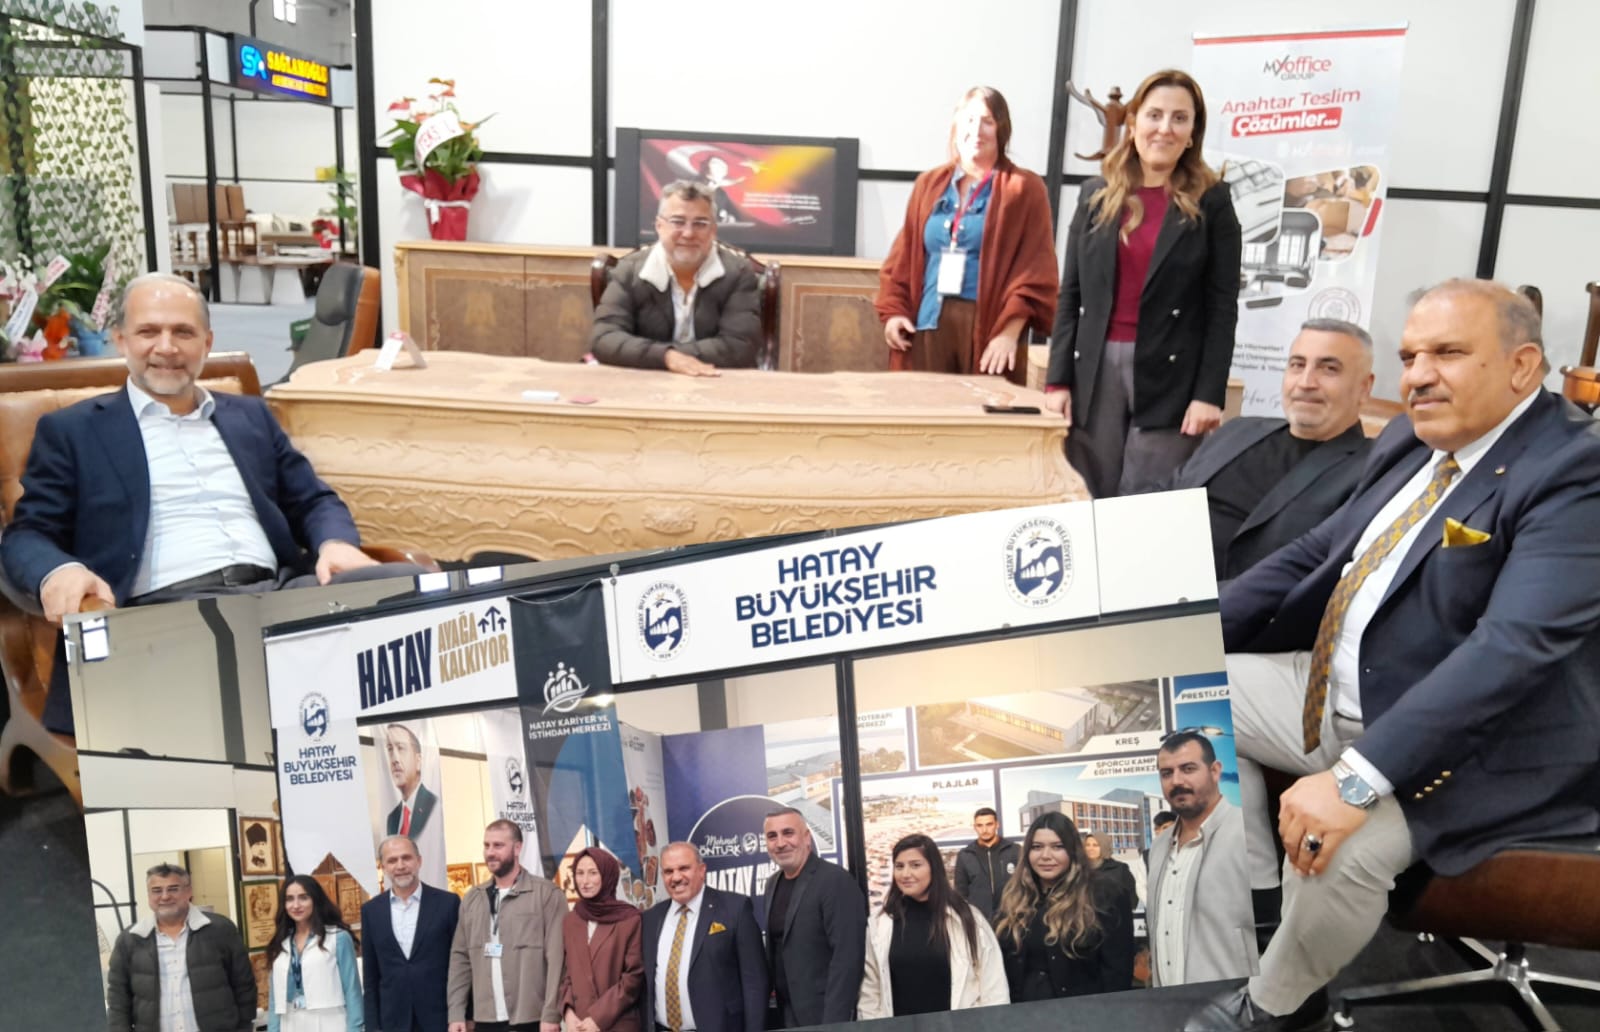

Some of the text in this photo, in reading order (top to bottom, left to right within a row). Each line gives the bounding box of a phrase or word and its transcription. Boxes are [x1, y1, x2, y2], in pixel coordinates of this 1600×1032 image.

[1221, 88, 1361, 115] Anahtar Teslim
[778, 541, 883, 584] HATAY
[735, 565, 937, 621] BÜYÜKŞEHİR
[751, 597, 923, 649] BELEDİYESİ
[356, 611, 479, 710] HATAY AYAĞA
[438, 633, 510, 684] KALKIYOR
[529, 720, 557, 731] HATAY
[558, 714, 597, 727] KARİYER
[572, 722, 612, 734] MERKEZİ
[1115, 737, 1140, 746] KREŞ
[299, 744, 337, 759] HATAY
[1096, 757, 1155, 768] SPORCU KAMP
[290, 769, 353, 785] BELEDİYESİ
[932, 778, 979, 789] PLAJLAR
